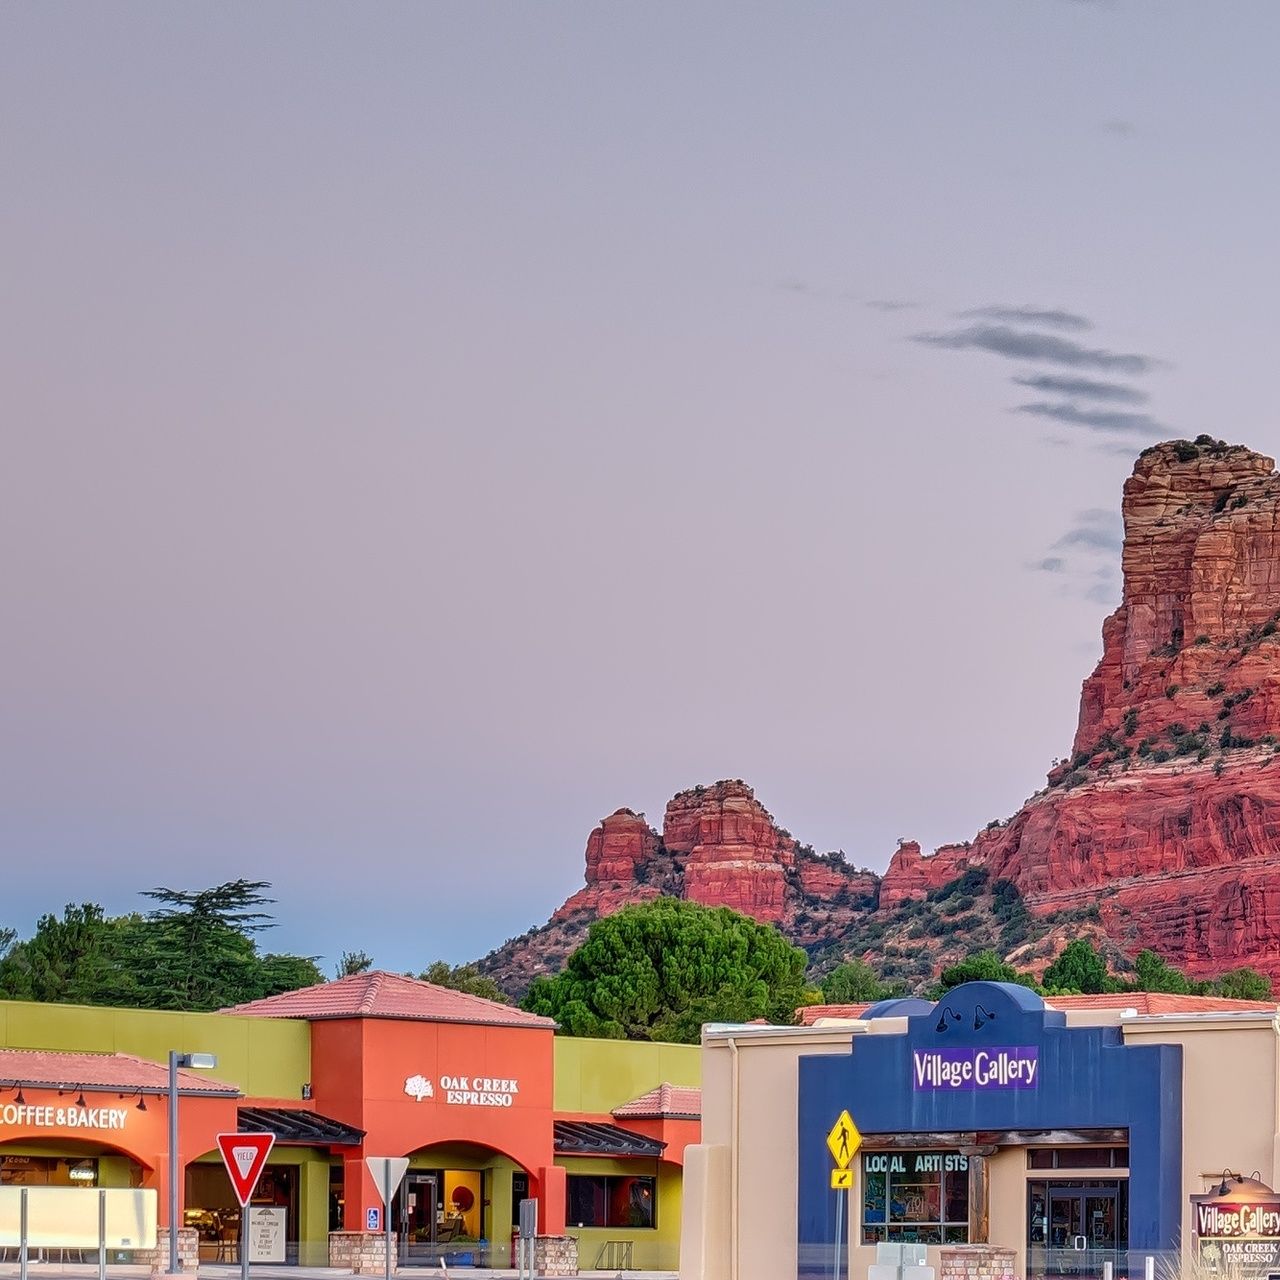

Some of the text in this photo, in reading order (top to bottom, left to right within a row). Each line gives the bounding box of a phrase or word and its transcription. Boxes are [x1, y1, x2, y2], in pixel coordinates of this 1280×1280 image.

[914, 1052, 1037, 1087] Village Gallery
[440, 1076, 519, 1093] OAK CREEK
[447, 1091, 513, 1107] ESPRESSO
[237, 1151, 254, 1161] YIELD
[865, 1154, 968, 1173] LOCAL ARTISTS
[1199, 1205, 1240, 1235] Village
[1222, 1243, 1278, 1253] OAK CREEK
[1227, 1253, 1273, 1263] ESPRESSO
